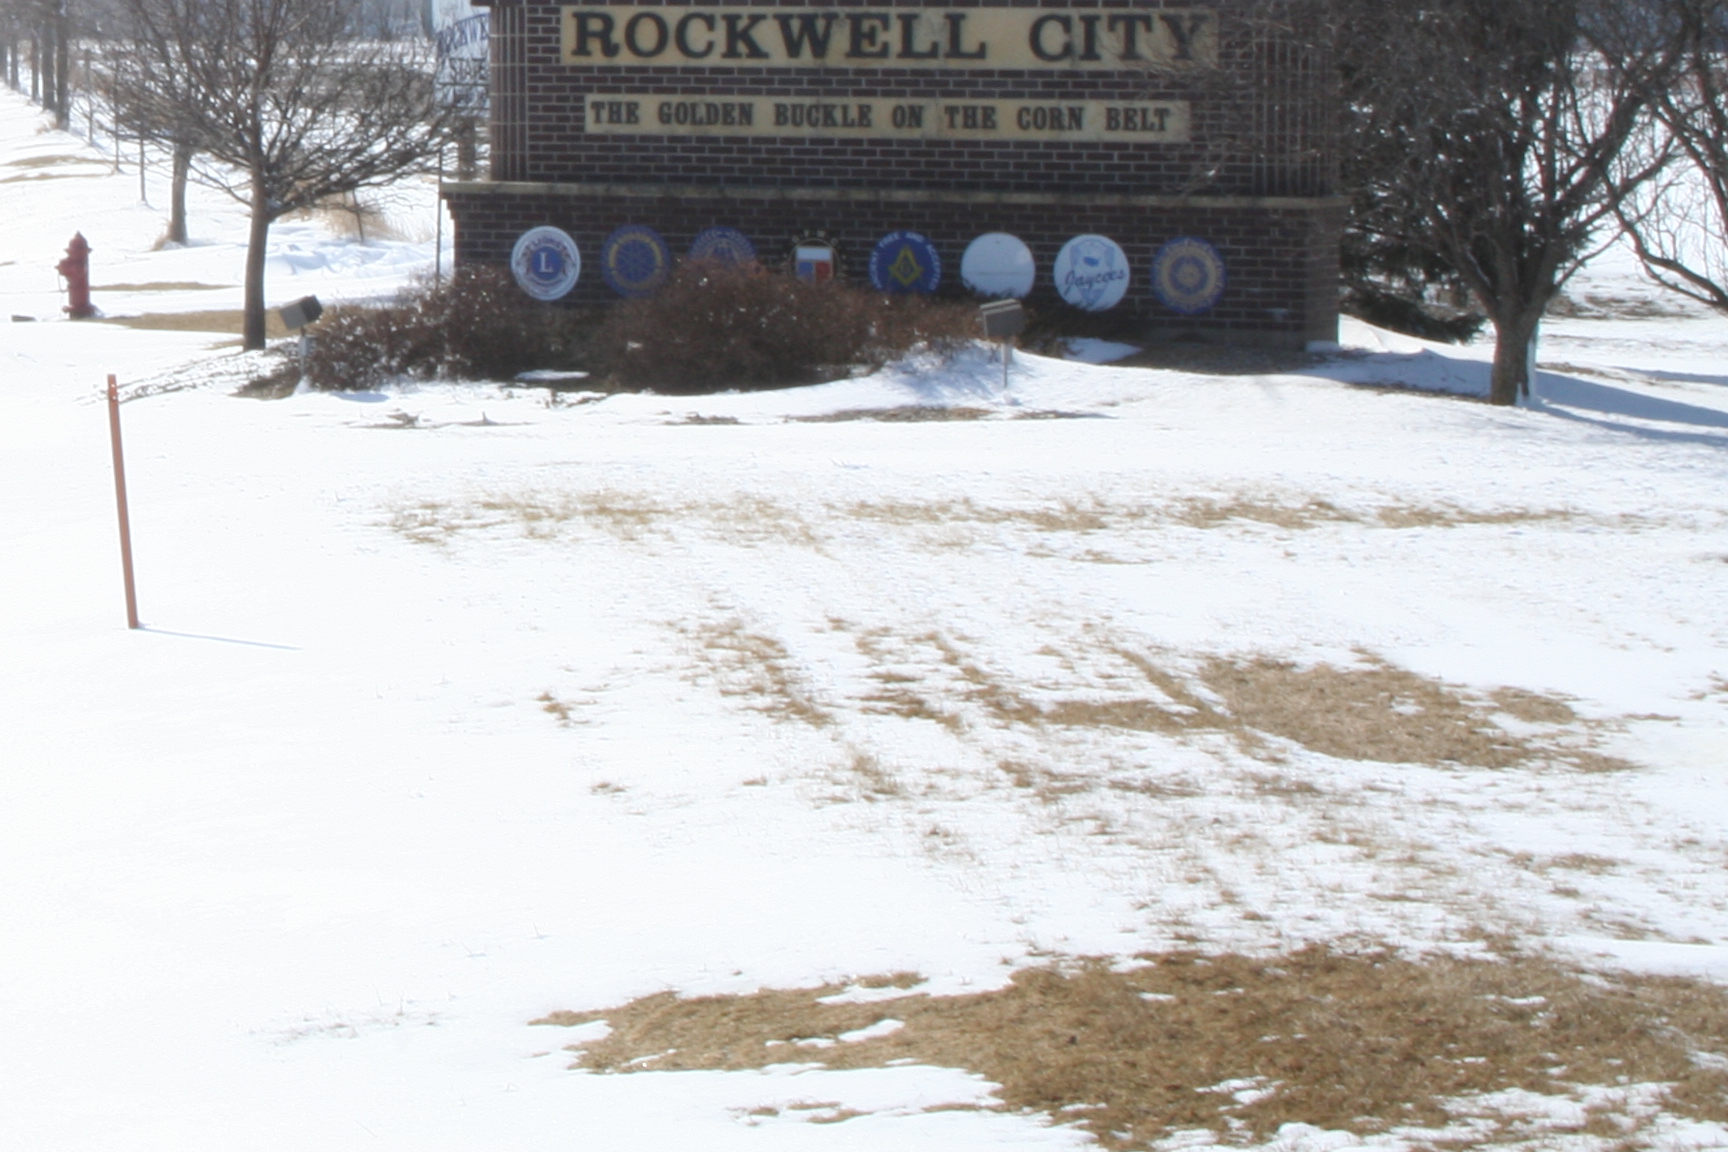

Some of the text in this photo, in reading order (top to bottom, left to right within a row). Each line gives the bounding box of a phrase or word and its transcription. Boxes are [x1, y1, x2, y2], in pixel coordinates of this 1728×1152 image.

[571, 11, 1208, 62] ROCKWELL CITY
[591, 101, 1171, 131] THE GOLDEN BUCKLE ON THE CORN BELT
[539, 252, 554, 273] L
